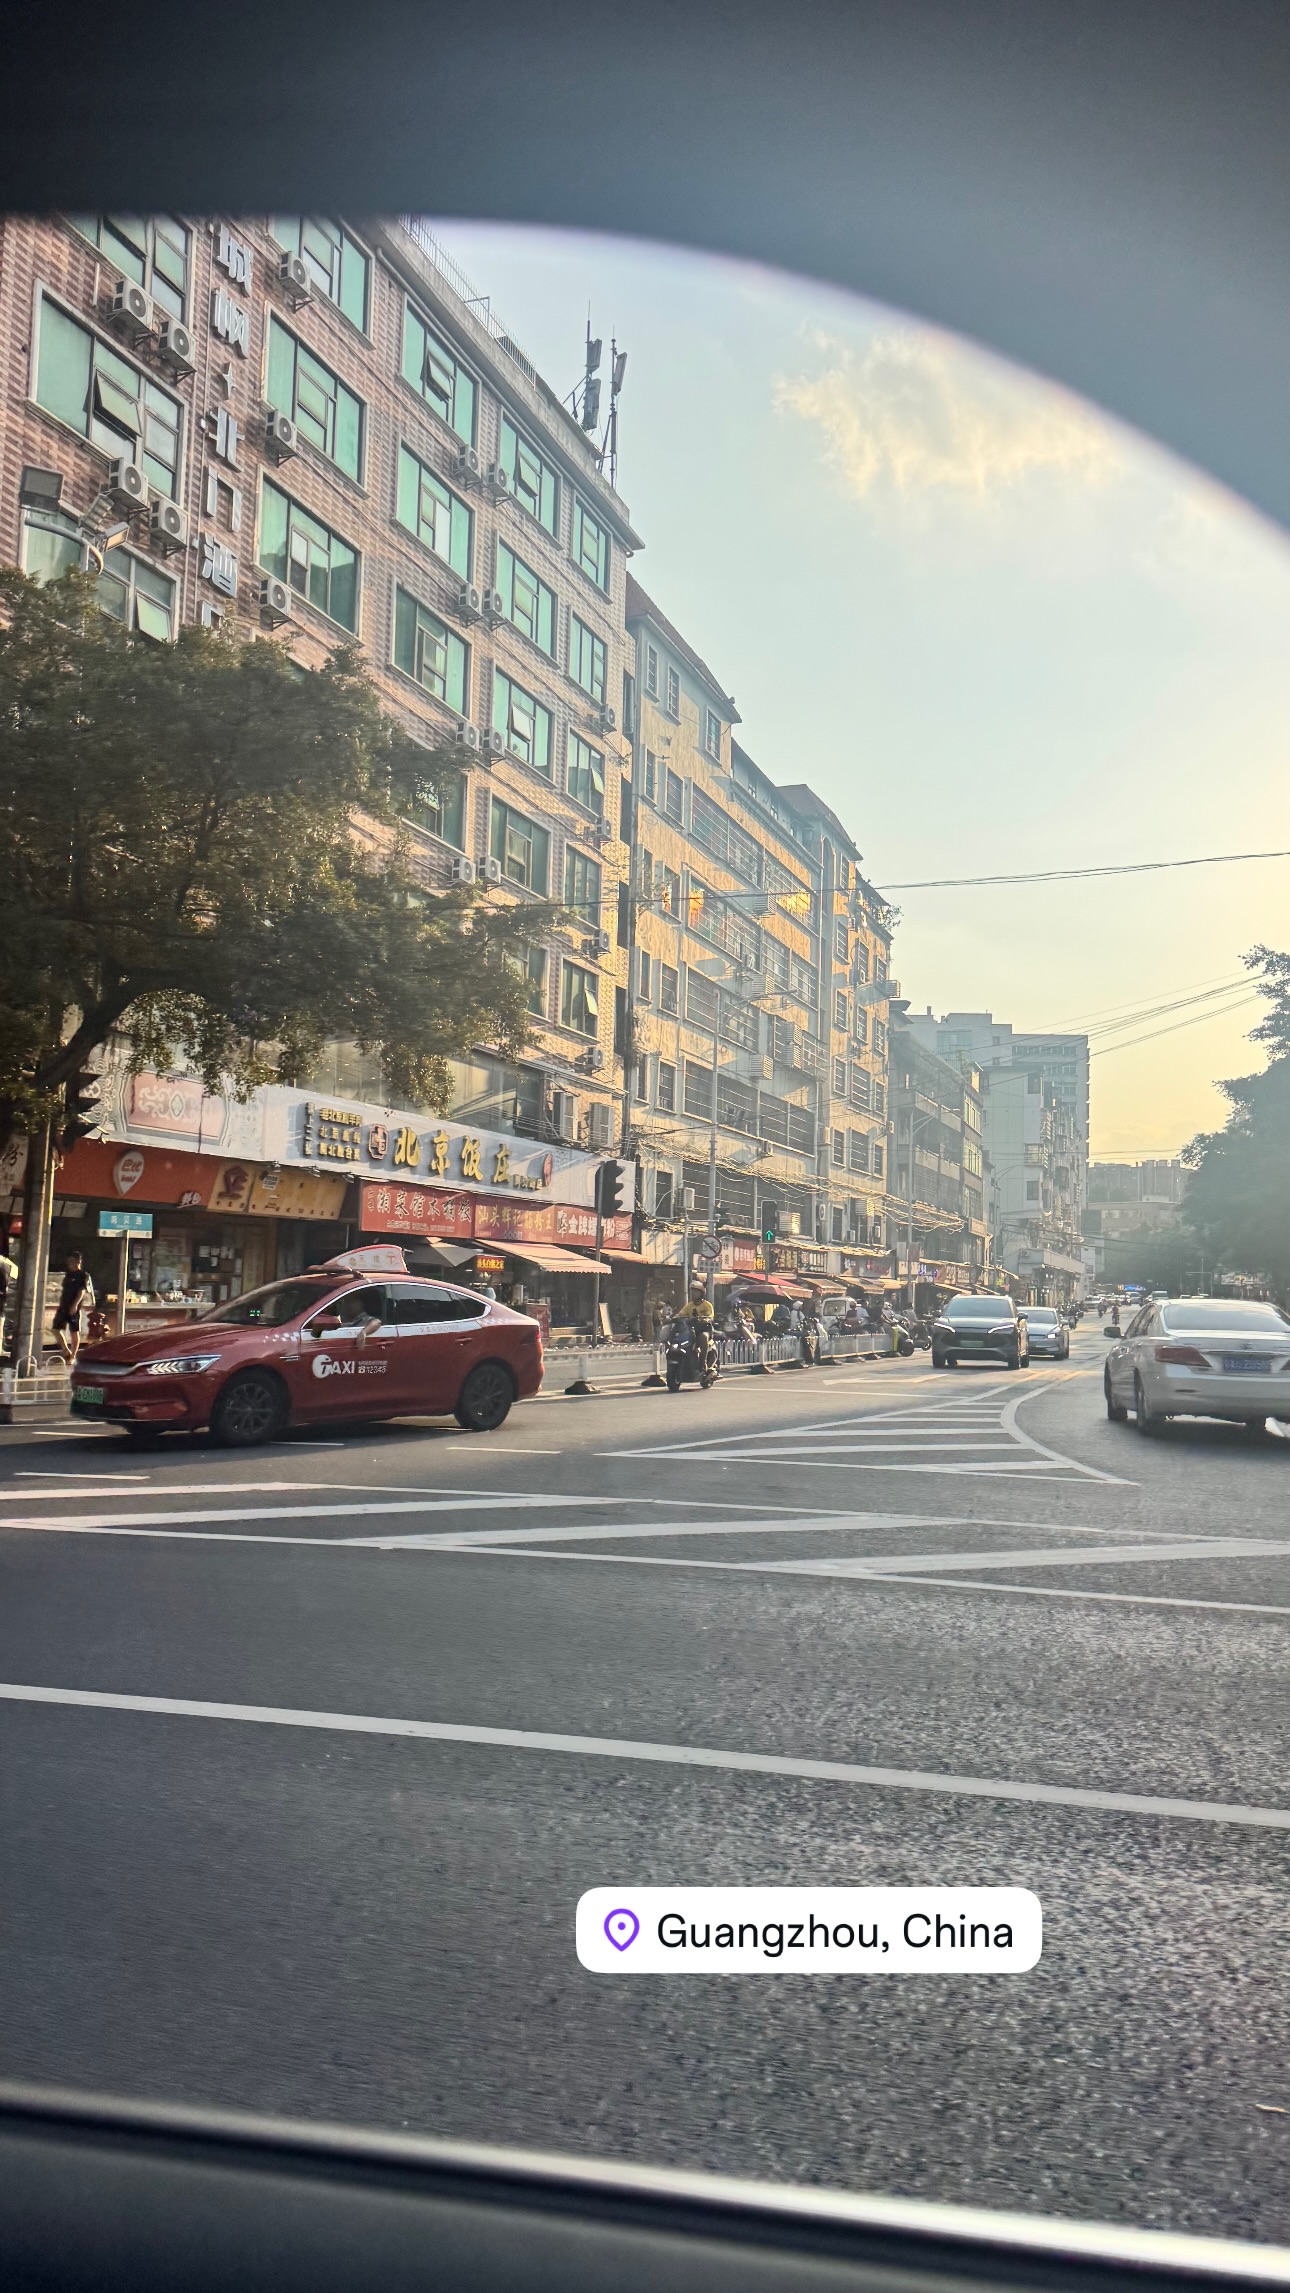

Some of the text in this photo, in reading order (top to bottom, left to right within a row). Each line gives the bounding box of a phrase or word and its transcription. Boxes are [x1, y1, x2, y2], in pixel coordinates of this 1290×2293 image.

[121, 1158, 142, 1172] 巴比
[394, 1126, 512, 1184] 北京饭庄
